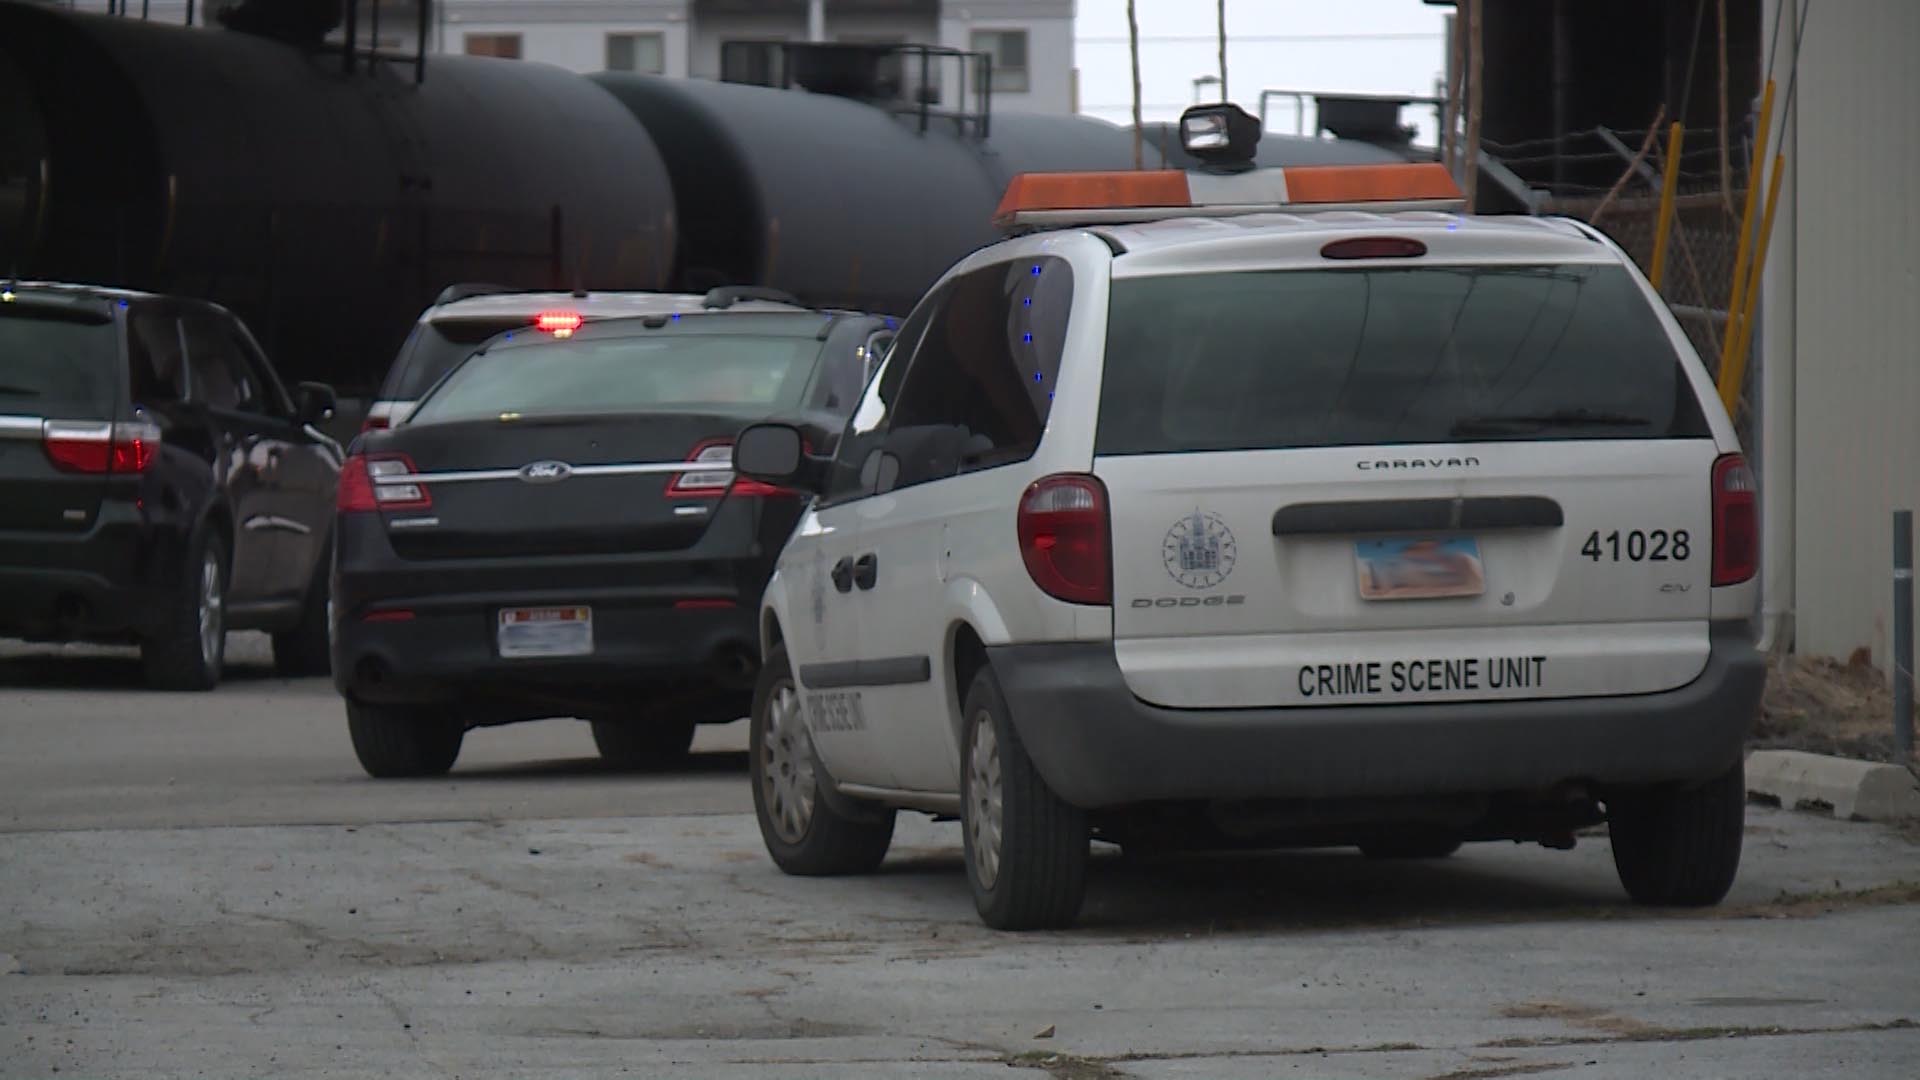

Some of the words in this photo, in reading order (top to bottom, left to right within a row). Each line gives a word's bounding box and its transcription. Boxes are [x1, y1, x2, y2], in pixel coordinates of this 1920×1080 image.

[1356, 457, 1481, 470] CARAVAN
[1581, 529, 1691, 562] 41028
[1131, 595, 1246, 608] DODGE
[1298, 662, 1382, 697] CRIME
[1390, 658, 1480, 693] SCENE
[1488, 656, 1547, 689] UNIT
